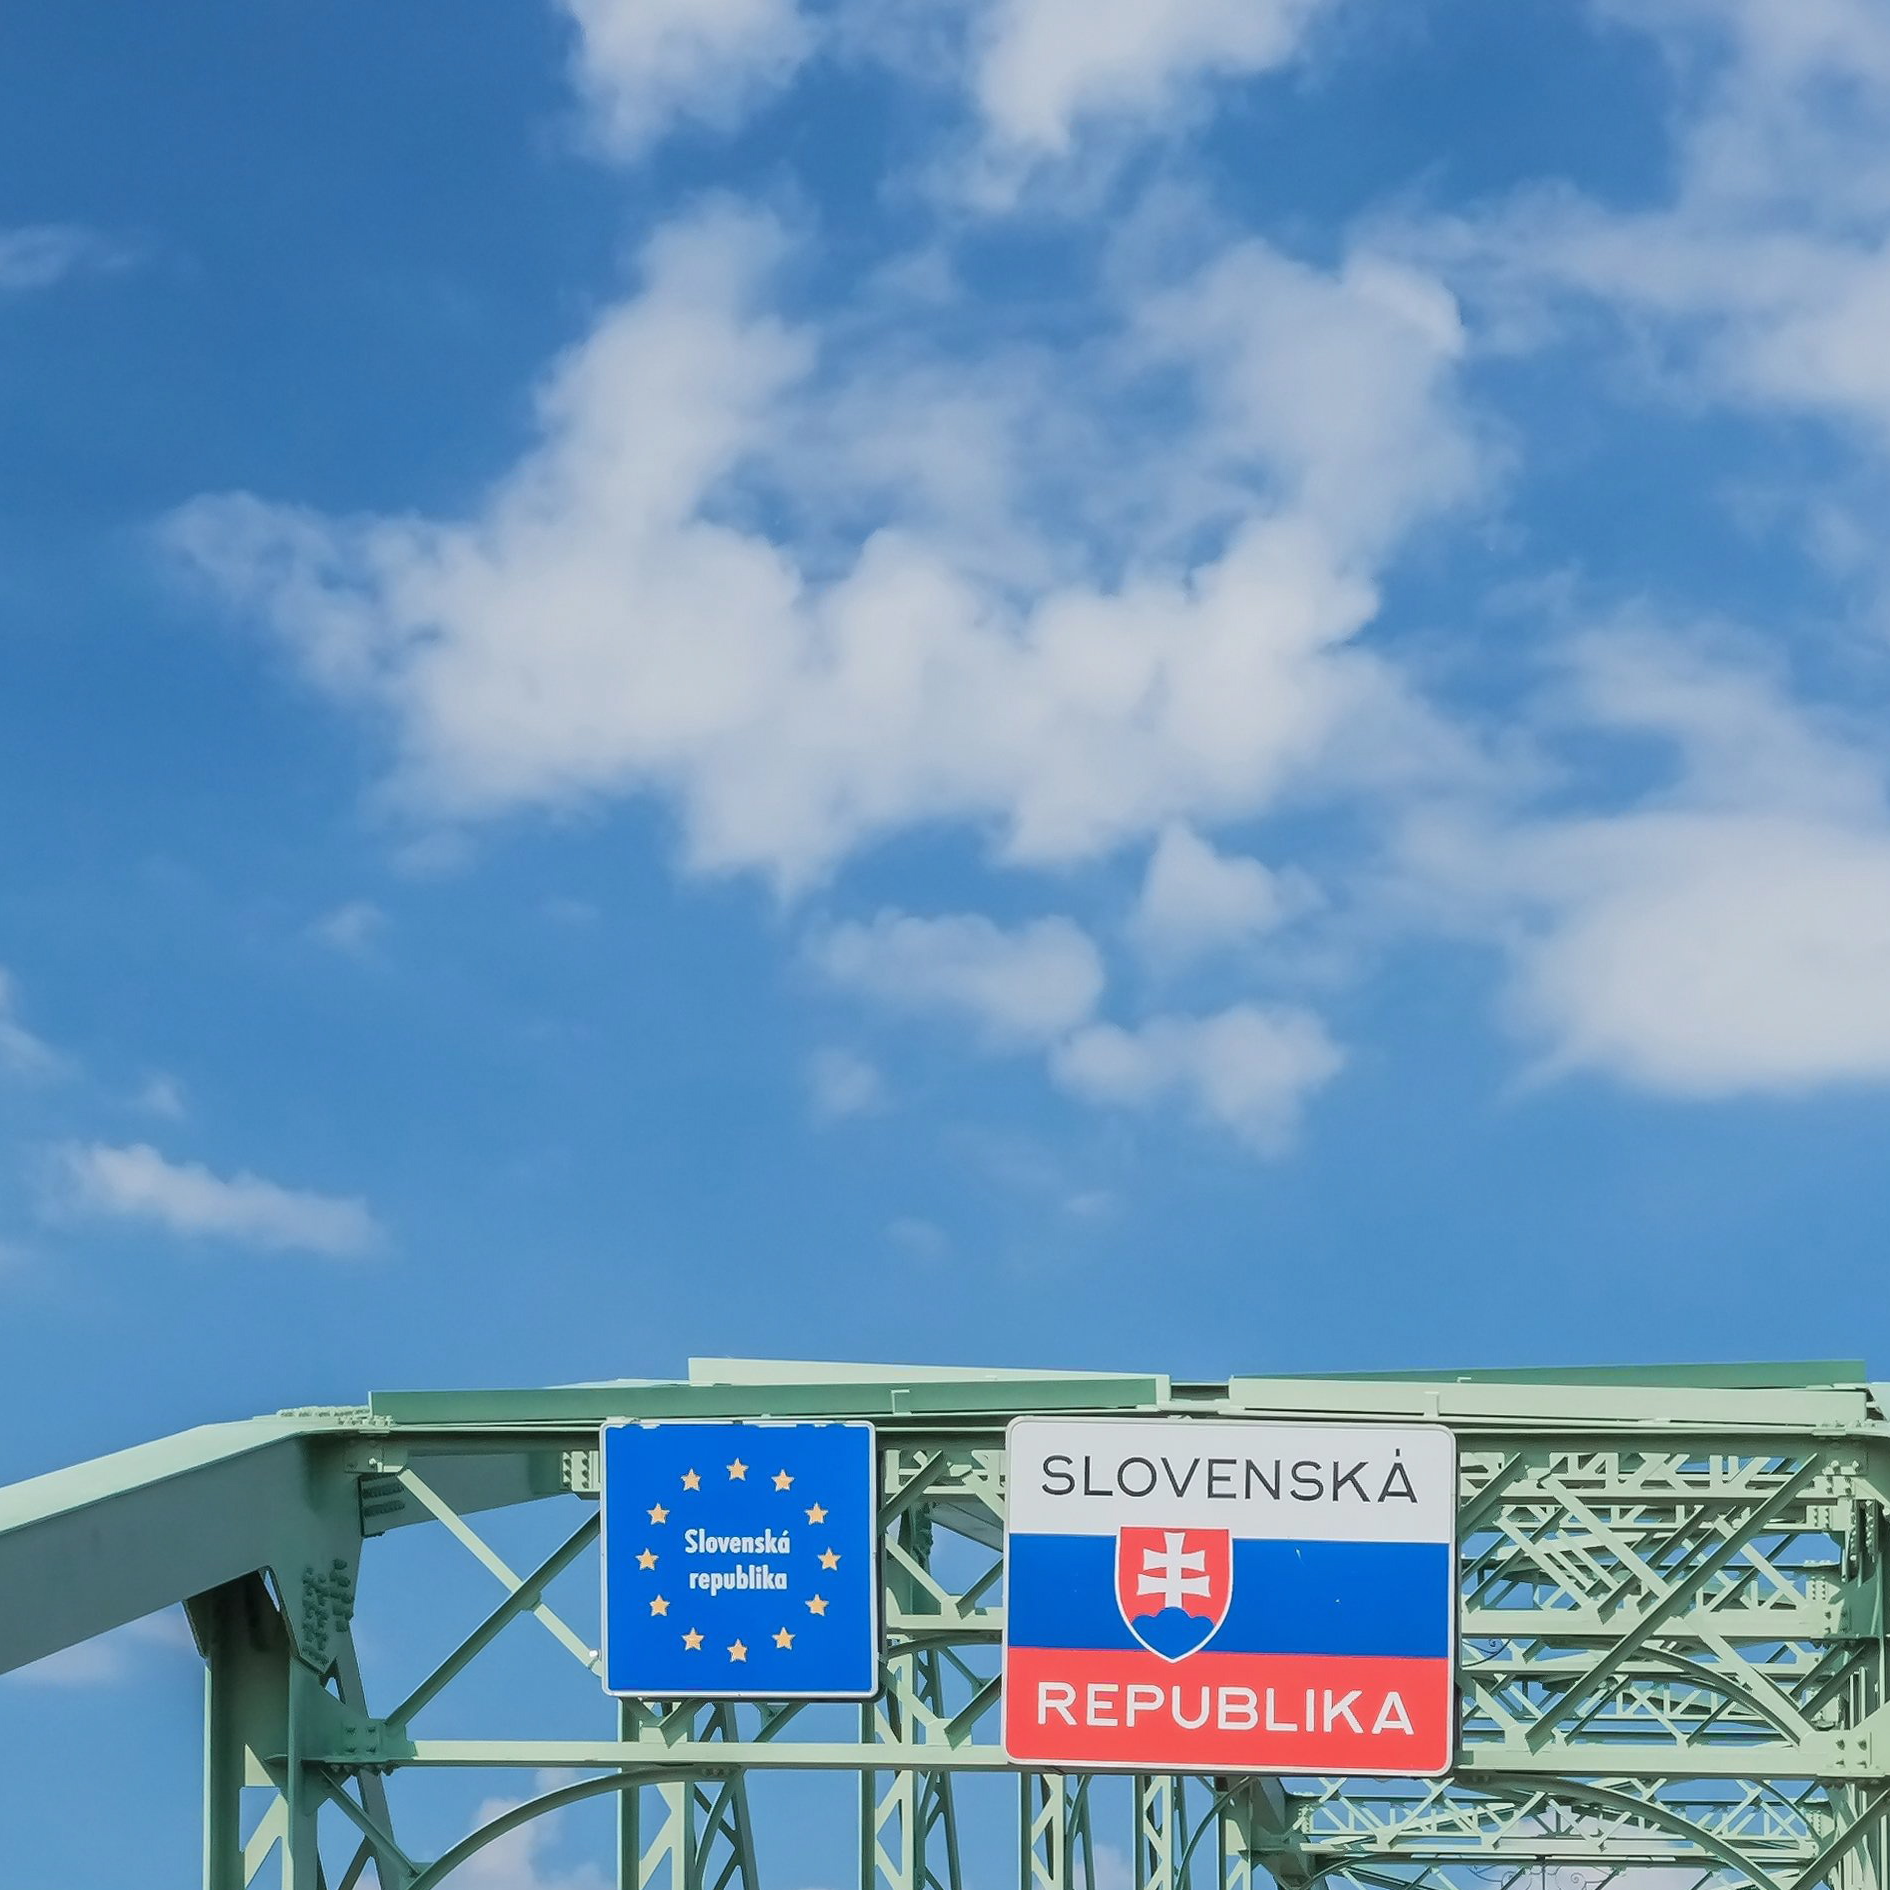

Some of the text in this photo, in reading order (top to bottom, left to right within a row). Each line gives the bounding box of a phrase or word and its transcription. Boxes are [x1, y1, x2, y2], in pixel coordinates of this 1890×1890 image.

[1041, 1448, 1419, 1504] SLOVENSKÁ
[684, 1528, 791, 1554] Slovenská
[689, 1564, 788, 1597] republika
[1037, 1681, 1415, 1735] REPUBLIKA
